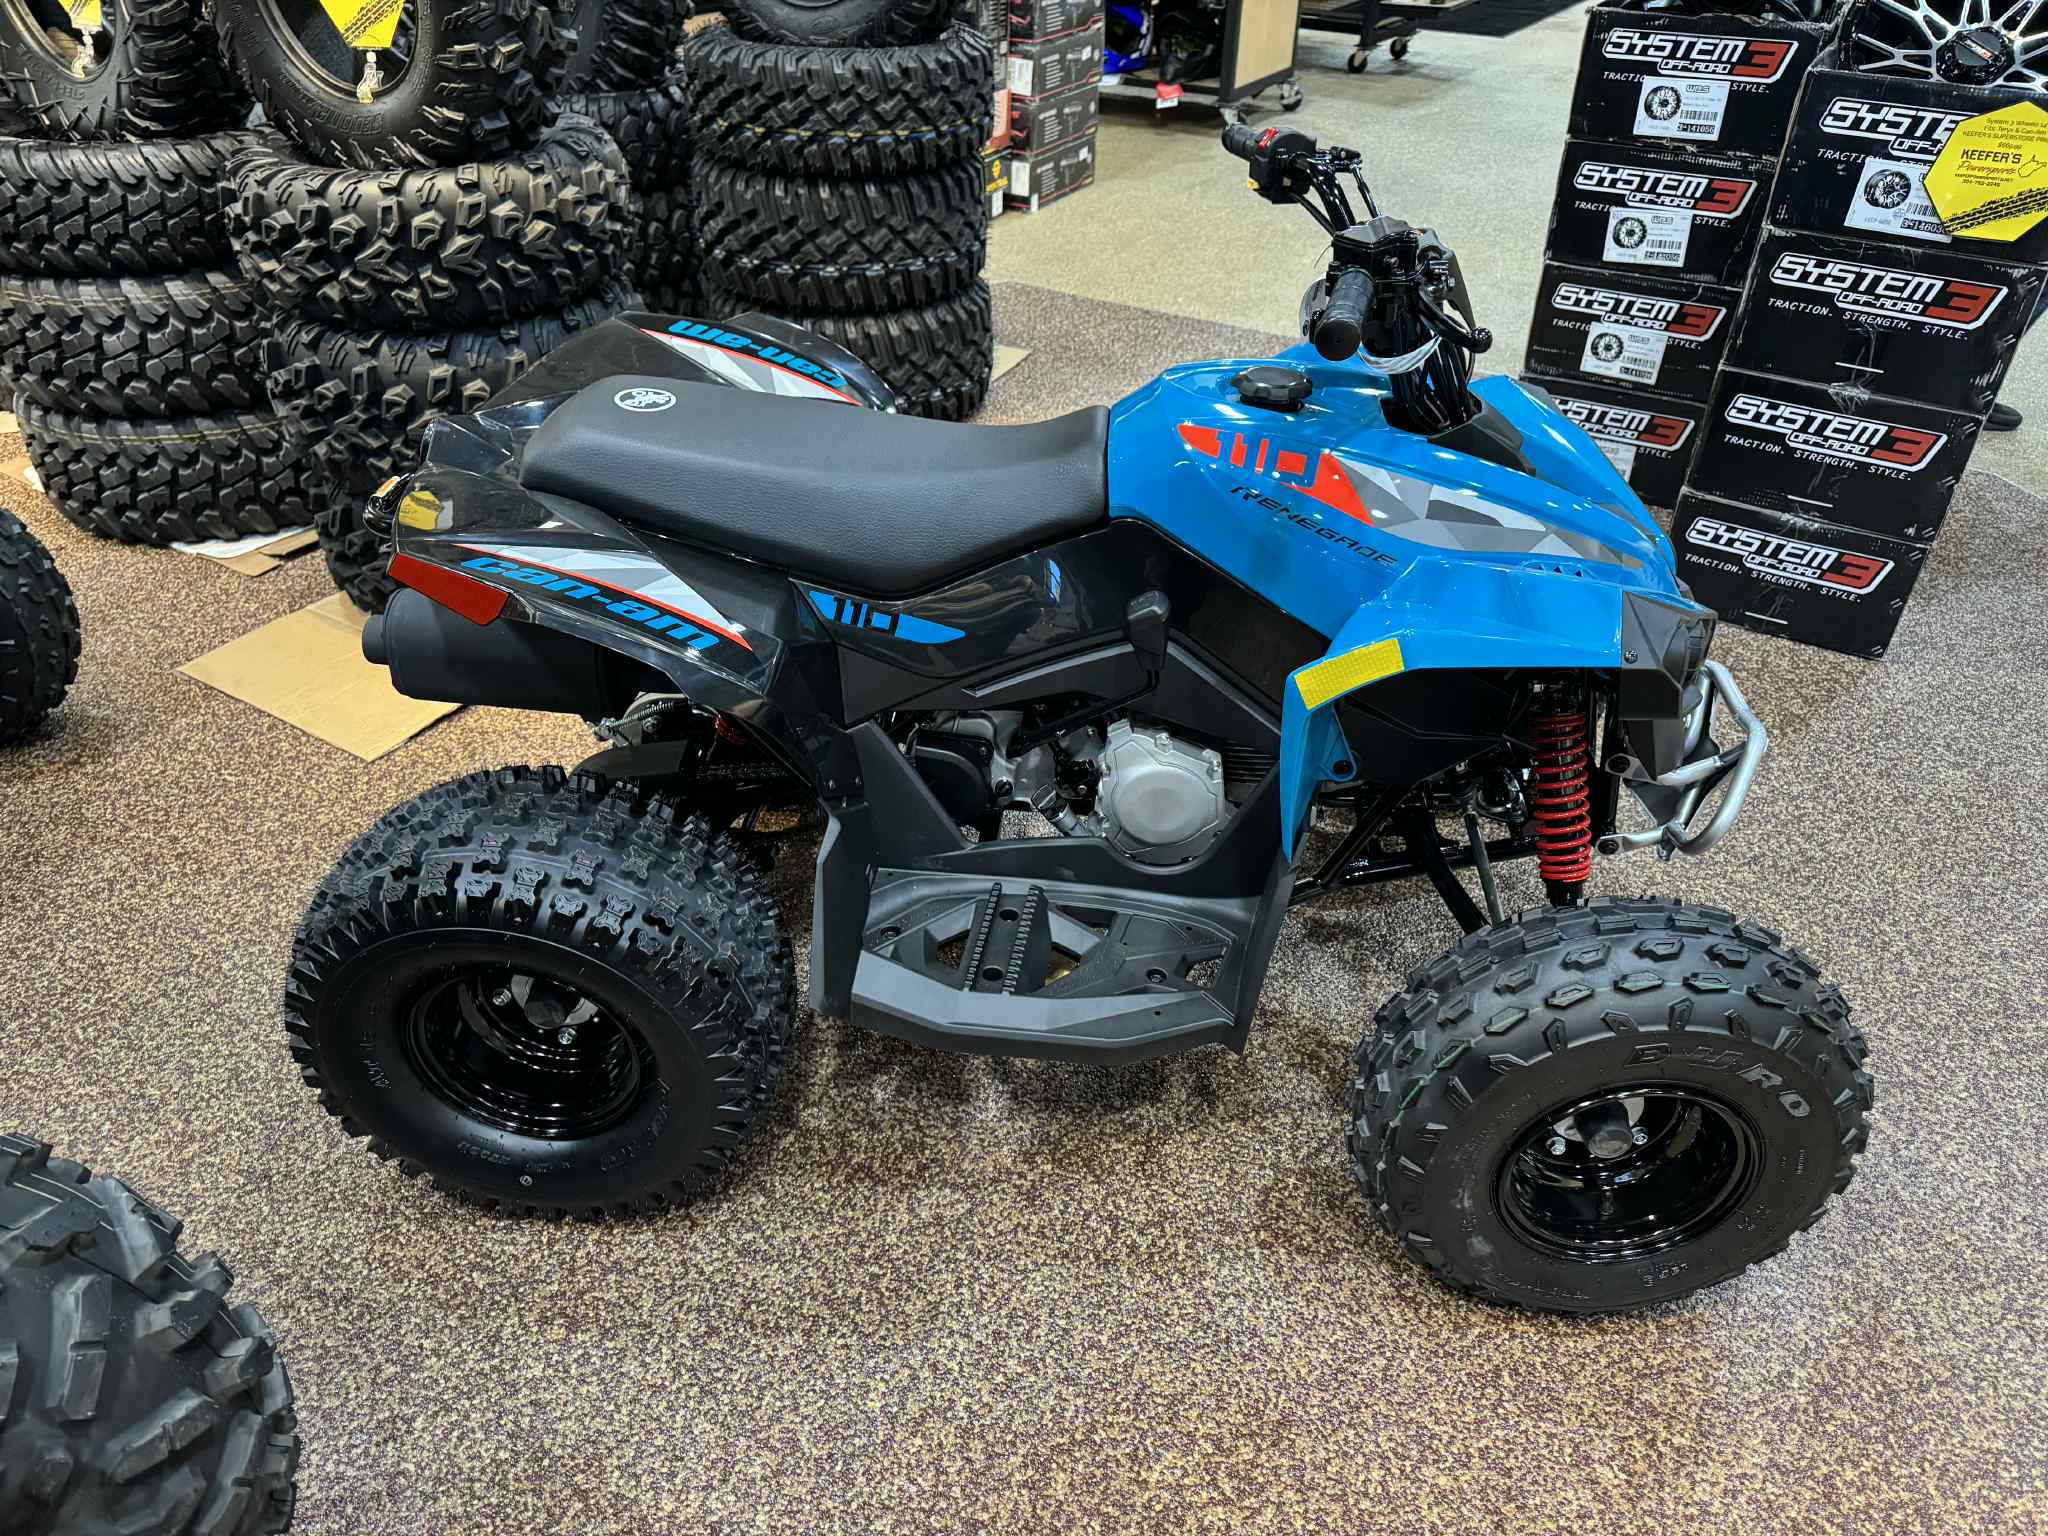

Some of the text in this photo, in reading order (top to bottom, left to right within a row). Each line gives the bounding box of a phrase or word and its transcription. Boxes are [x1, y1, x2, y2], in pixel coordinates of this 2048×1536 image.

[1605, 31, 1790, 77] SYSTEM 3
[1660, 59, 1732, 74] OFF-ROAD
[1730, 82, 1770, 94] STYLE.
[1823, 100, 1968, 141] SYSTE
[1960, 148, 2022, 164] KEEFER'S
[1576, 164, 1750, 212] SYSTEM 3
[1629, 191, 1695, 208] OFF-ROAD
[1694, 216, 1731, 228] STYLE.
[1772, 254, 1998, 322] SYSTEM 3
[1837, 290, 1924, 314] OFF-ROAD
[1555, 286, 1721, 337] SYSTEM 3
[1603, 312, 1668, 330] OFF-ROAD
[1767, 298, 1968, 341] TRACTION. STRENGTH. STYLE.
[1667, 337, 1702, 350] STYLE.
[1554, 398, 1690, 447] YSTEM 3
[1727, 396, 1937, 465] SYSTEM 3
[1788, 431, 1870, 456] OFF-ROAD
[1723, 434, 1911, 481] TRACTION. STRENGTH. STYLE.
[1230, 485, 1399, 567] RENEGADE
[1688, 519, 1884, 589] SYSTEM 3
[1746, 553, 1822, 578] OFF-ROAD
[1684, 553, 1861, 603] TRACTION. STRENGTH. STYLE.
